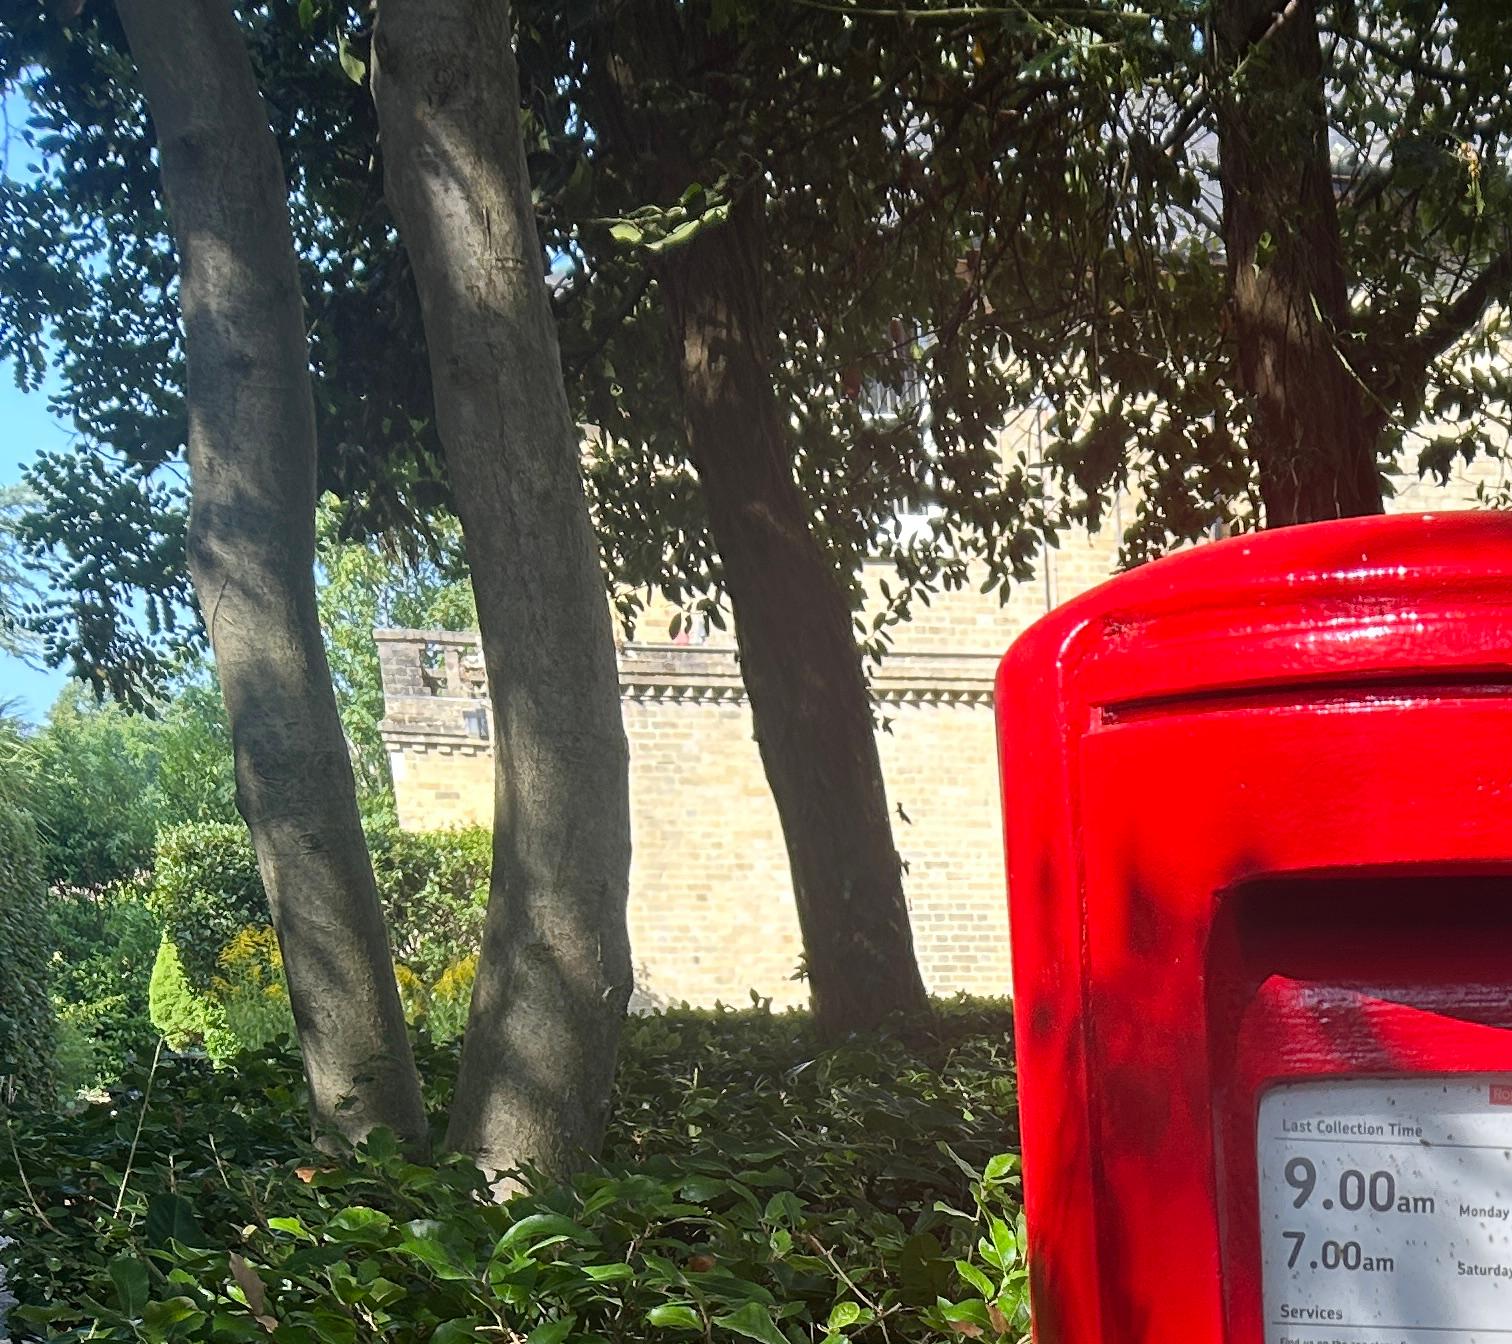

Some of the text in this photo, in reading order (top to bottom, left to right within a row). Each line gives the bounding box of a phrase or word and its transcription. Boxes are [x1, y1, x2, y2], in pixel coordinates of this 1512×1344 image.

[1282, 1119, 1423, 1137] Last Collection Time
[1284, 1157, 1435, 1214] 9.00am
[1459, 1204, 1509, 1220] Monday
[1282, 1231, 1394, 1272] 7.00am
[1280, 1304, 1343, 1320] Services
